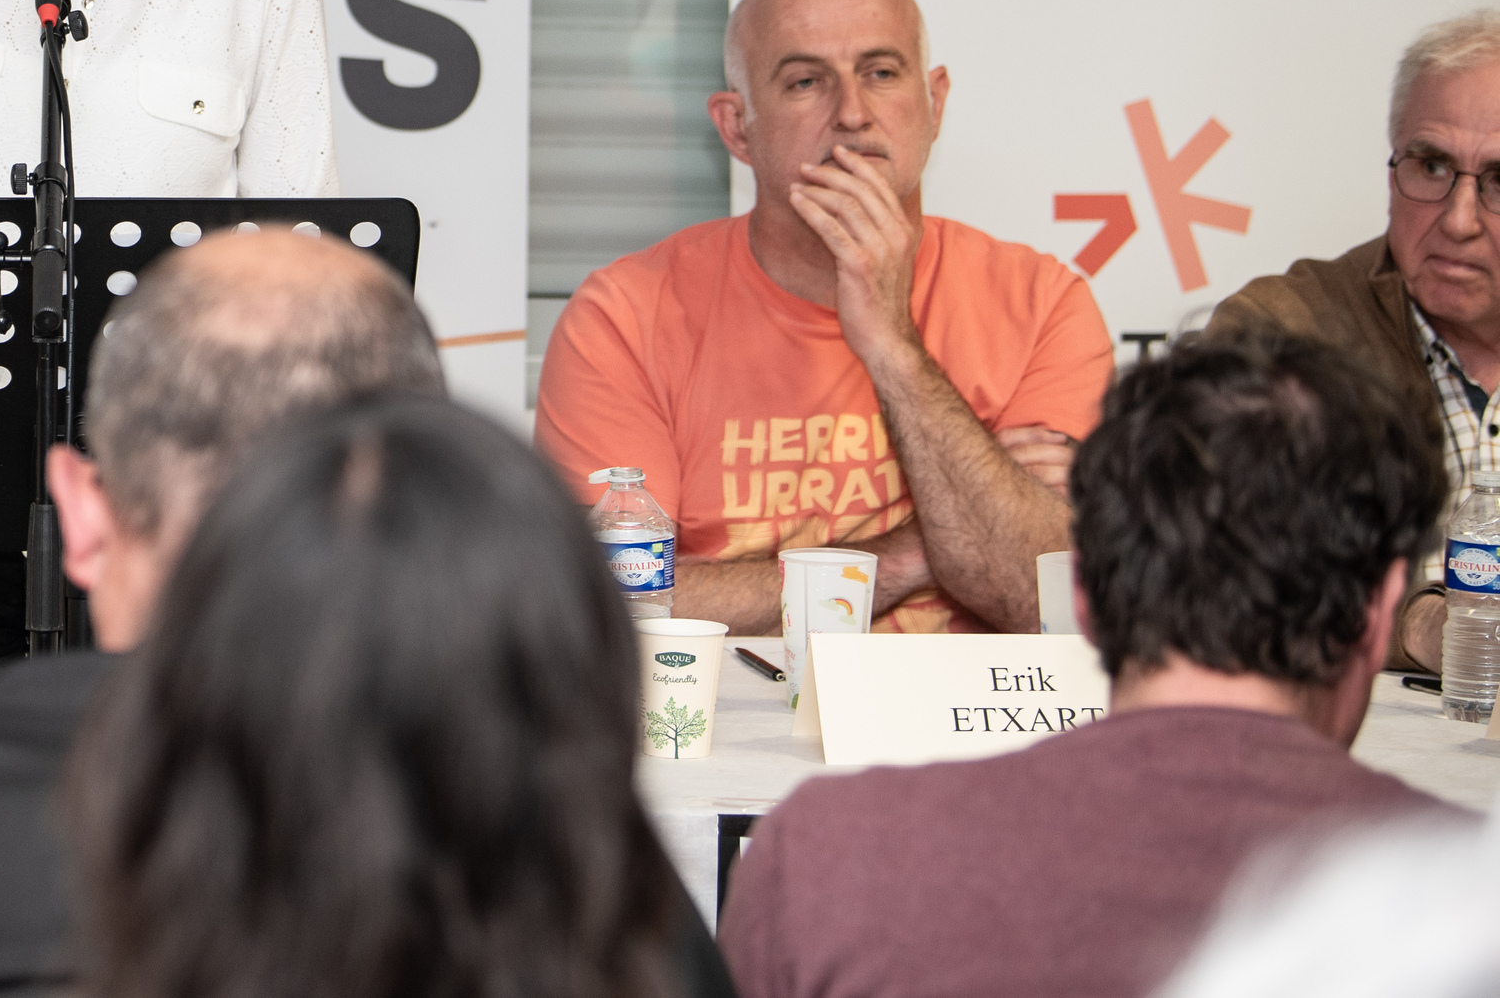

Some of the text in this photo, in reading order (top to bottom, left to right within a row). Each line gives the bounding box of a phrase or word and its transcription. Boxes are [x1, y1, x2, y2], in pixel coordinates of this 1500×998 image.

[719, 413, 889, 466] HERRI
[721, 459, 902, 519] URRAT
[610, 560, 663, 571] RISTALINE
[1449, 559, 1500, 572] CRISTALIN
[652, 672, 698, 686] Ecofriendly
[988, 666, 1059, 692] Erik
[950, 707, 1105, 733] ETXART
